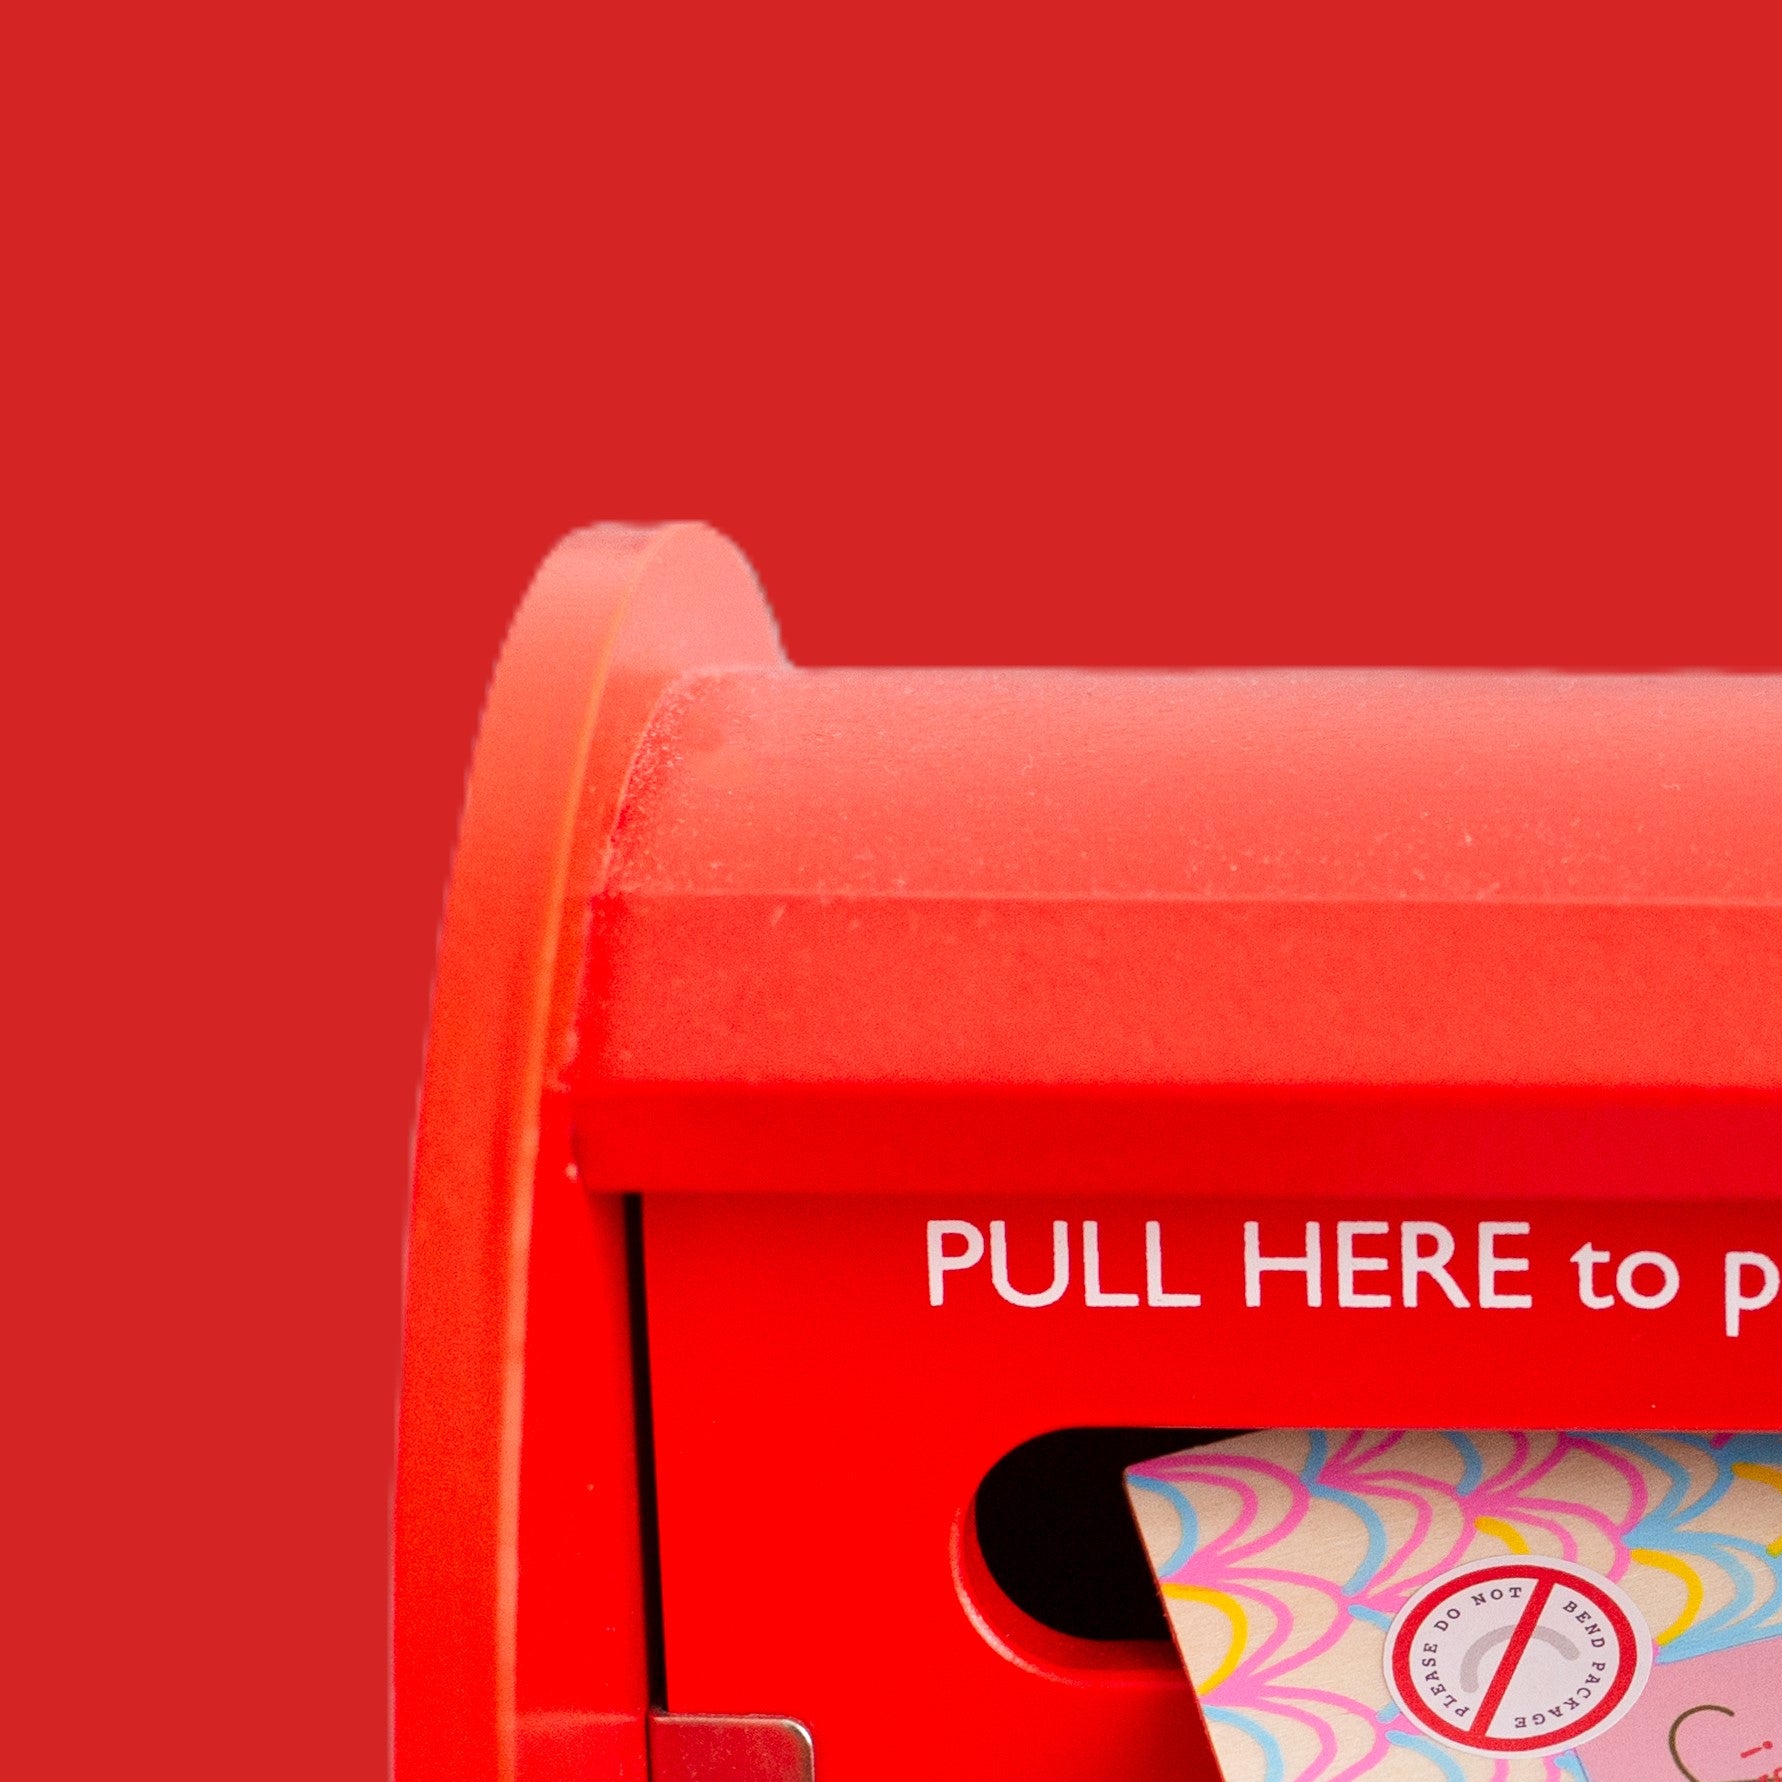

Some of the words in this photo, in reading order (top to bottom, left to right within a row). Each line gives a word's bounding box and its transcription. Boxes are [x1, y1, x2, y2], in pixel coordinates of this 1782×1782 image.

[927, 1220, 1201, 1308] PULL
[1244, 1221, 1533, 1309] HERE
[1570, 1242, 1680, 1310] to
[1434, 1607, 1461, 1632] DO
[1471, 1586, 1523, 1607] NOT
[1562, 1600, 1606, 1649] BEND
[1421, 1642, 1471, 1718] PLEASE
[1514, 1660, 1606, 1729] PACKAGE
